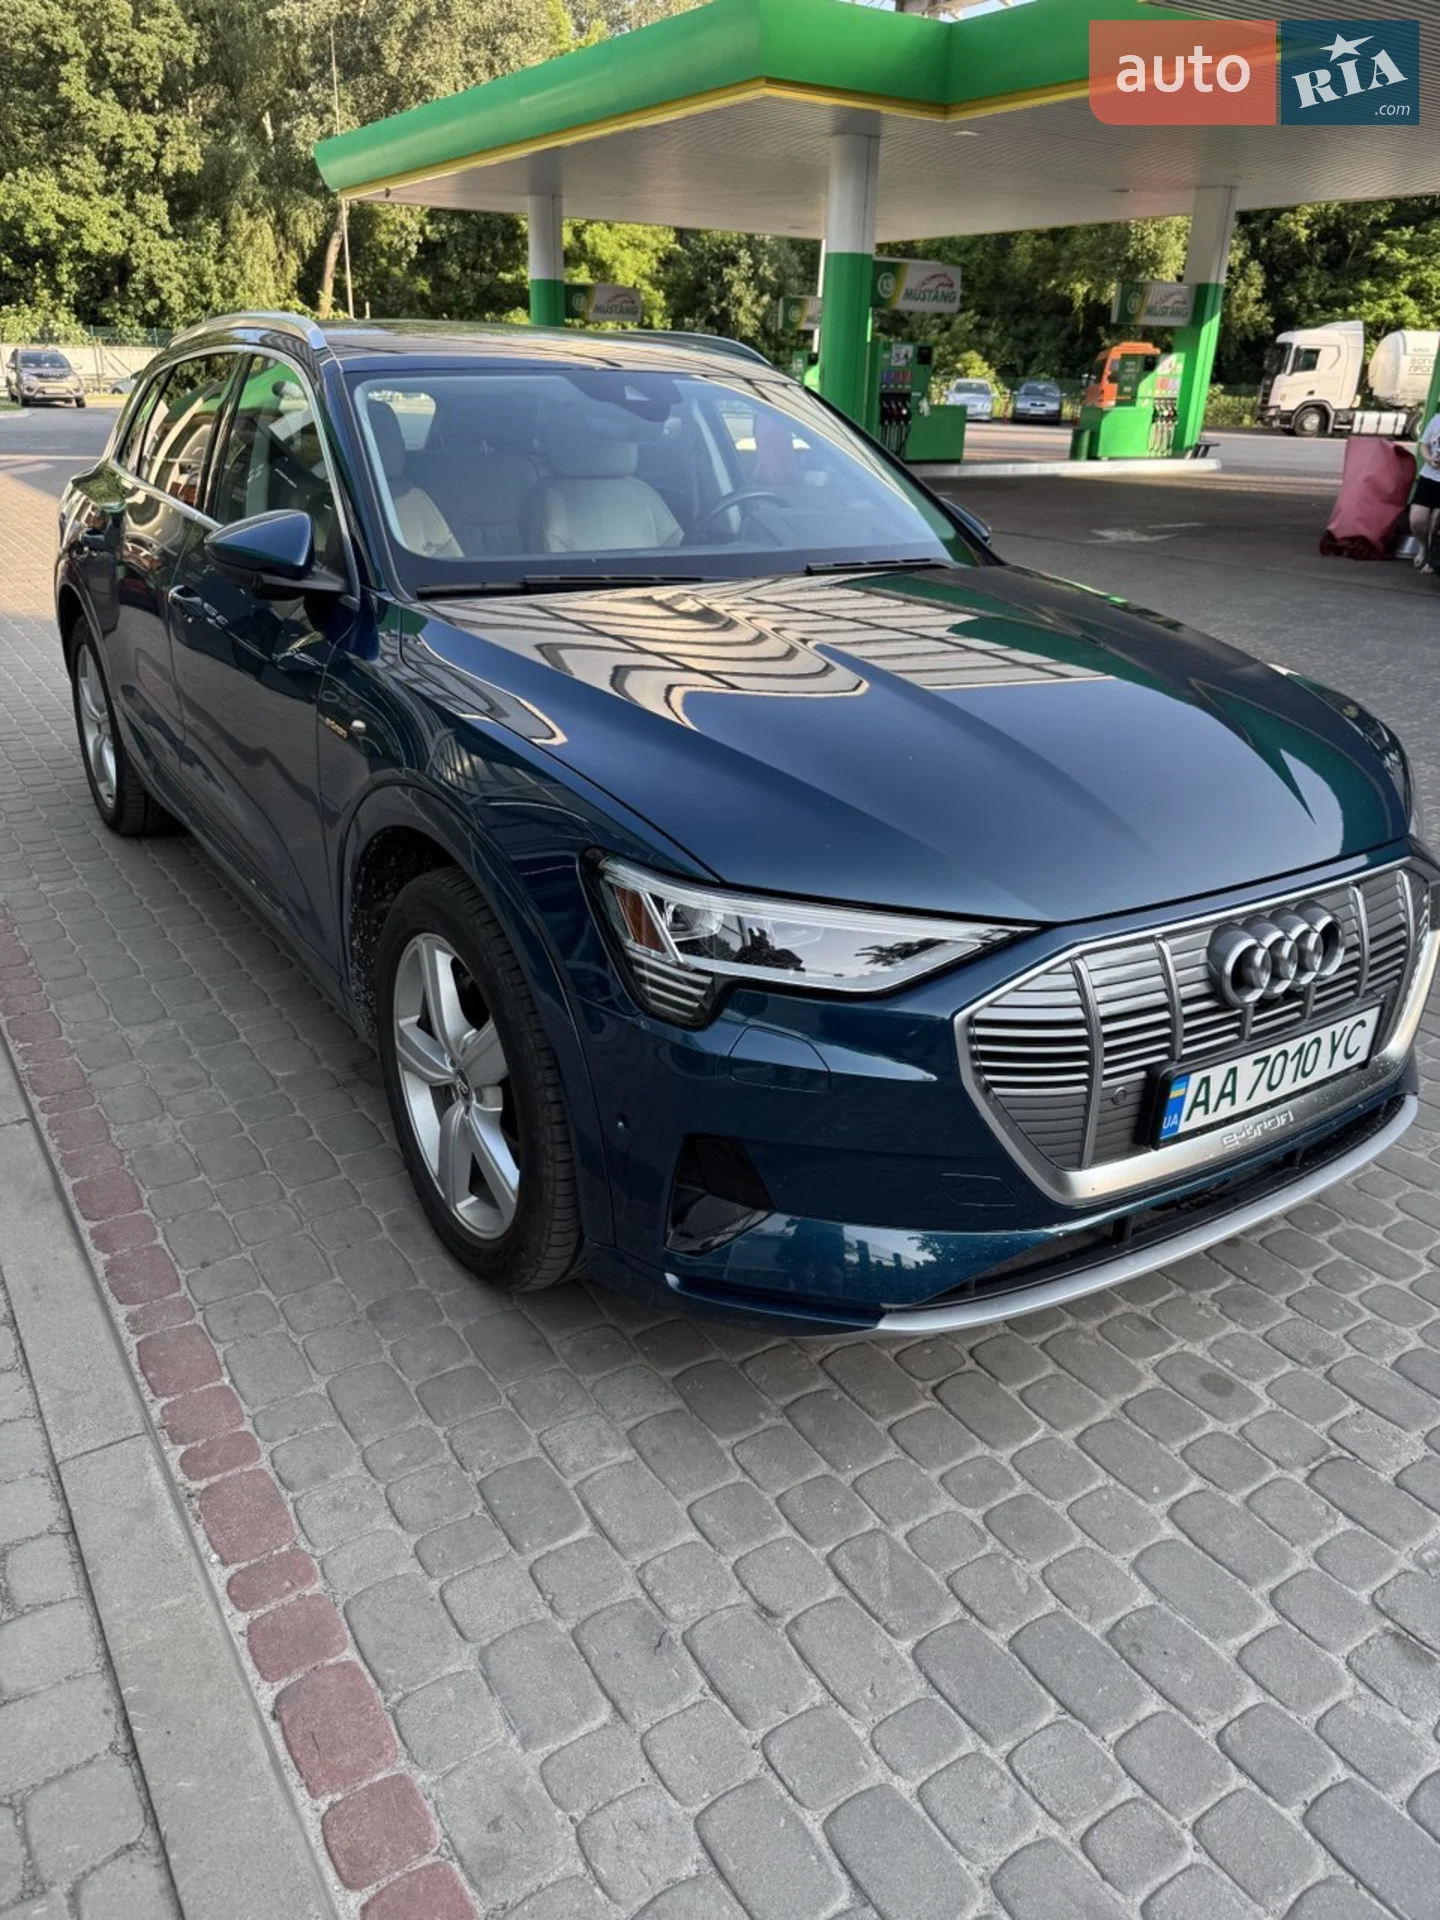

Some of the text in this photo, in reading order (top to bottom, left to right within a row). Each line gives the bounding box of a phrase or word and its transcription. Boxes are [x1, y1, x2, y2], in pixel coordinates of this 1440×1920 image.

[902, 286, 959, 304] MUSTANG
[1184, 1065, 1239, 1122] AA
[1246, 1036, 1322, 1102] 7010
[1162, 1114, 1179, 1130] UA
